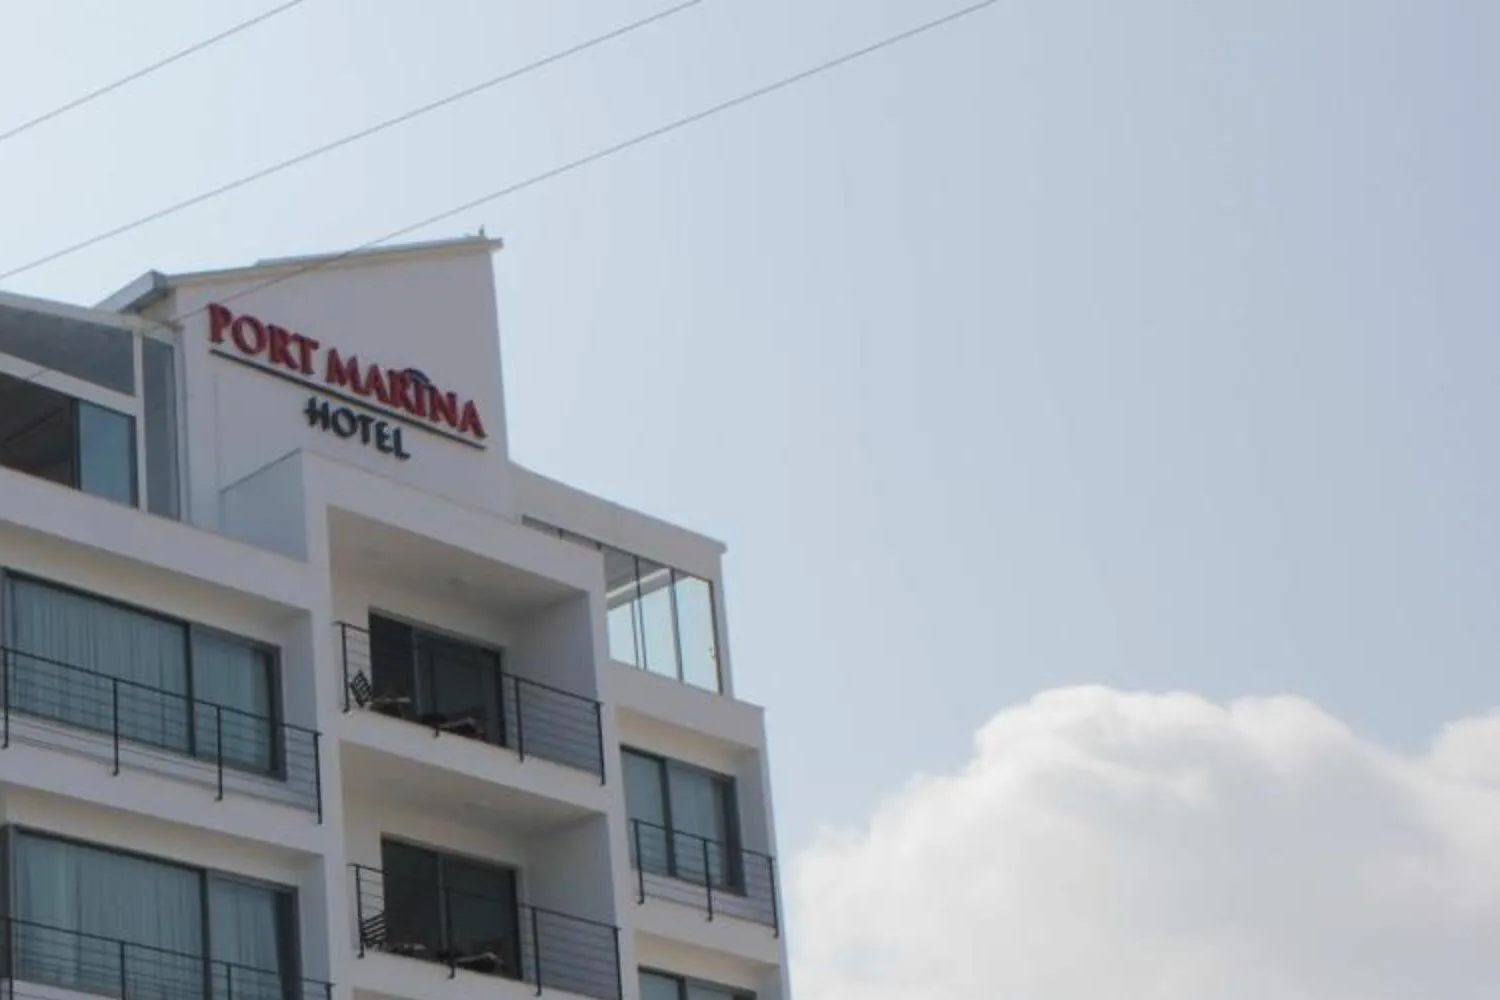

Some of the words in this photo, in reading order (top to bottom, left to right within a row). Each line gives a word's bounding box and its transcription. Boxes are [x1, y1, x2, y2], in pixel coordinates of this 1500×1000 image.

[207, 303, 320, 375] PORT
[326, 347, 487, 439] MARINA
[304, 396, 411, 460] HOTEL
